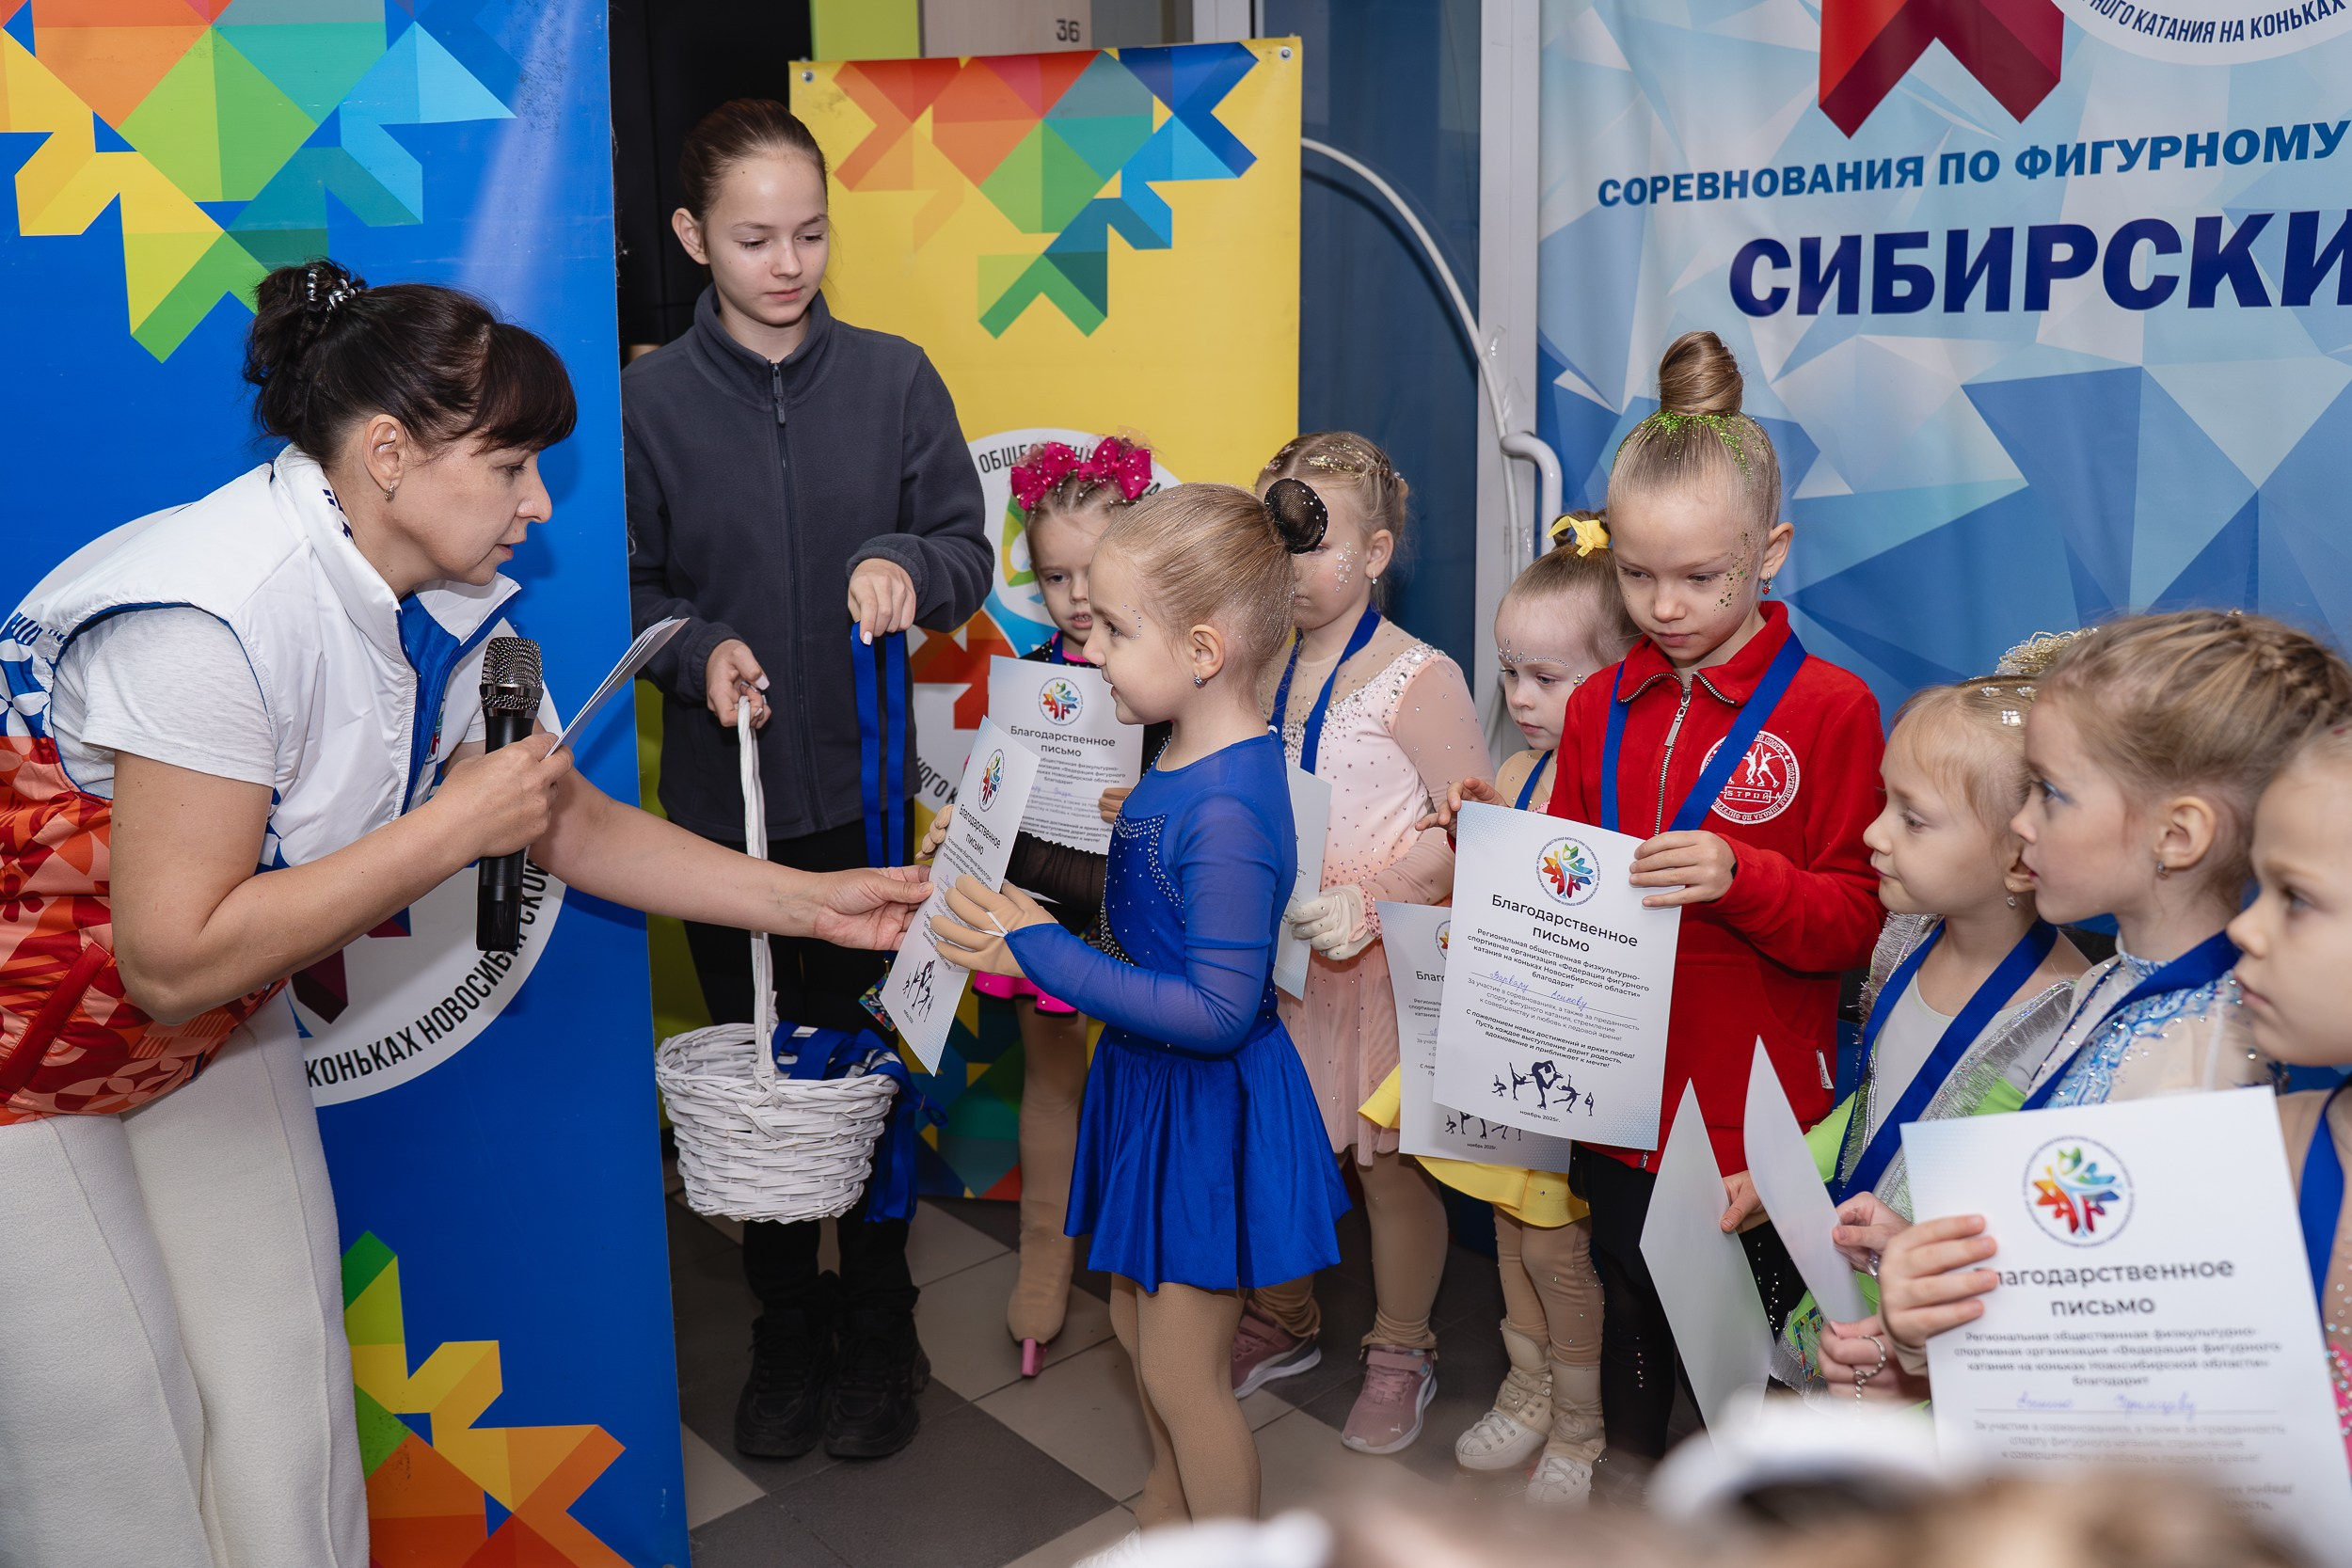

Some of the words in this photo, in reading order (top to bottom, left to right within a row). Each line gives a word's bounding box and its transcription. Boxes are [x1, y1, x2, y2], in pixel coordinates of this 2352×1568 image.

[1057, 19, 1080, 42] 36
[2132, 8, 2215, 43] КАТАНИЯ
[2218, 20, 2245, 43] НА
[2250, 0, 2346, 40] КОНЬКАХ
[1597, 155, 1924, 207] СОРЕВНОВАНИЯ
[1938, 150, 2000, 185] ПО
[2014, 119, 2352, 180] ФИГУРНОМУ
[1729, 209, 2352, 318] СИБИРСКИ
[1010, 725, 1116, 747] Благодарственное
[1041, 744, 1082, 757] письмо
[1492, 894, 1638, 947] Благодарственное
[1533, 927, 1590, 953] письмо
[1468, 935, 1509, 951] спортивная
[1510, 948, 1557, 967] организация
[1559, 963, 1605, 980] «Федерация
[1606, 976, 1649, 991] фигурного
[1473, 945, 1502, 958] катания
[1514, 958, 1542, 971] коньках
[1544, 966, 1603, 989] Новосибирской
[1604, 985, 1641, 998] области»
[1477, 928, 1528, 948] Региональная
[1529, 944, 1581, 965] общественная
[1582, 960, 1640, 981] физкультурно-
[1532, 971, 1574, 989] благодарит
[1476, 980, 1501, 992] участие
[1506, 990, 1558, 1011] соревнованиях,
[1564, 1007, 1583, 1017] также
[1594, 1017, 1640, 1031] преданность
[1485, 999, 1530, 1019] совершенству
[1536, 1015, 1562, 1027] любовь
[1567, 1024, 1597, 1037] ледовой
[1486, 992, 1508, 1005] спорту
[1509, 1000, 1544, 1015] фигурного
[1573, 1019, 1615, 1034] стремление
[1471, 1011, 1513, 1028] пожеланием
[1514, 1024, 1535, 1035] новых
[1536, 1031, 1580, 1047] достижений
[1586, 1045, 1609, 1054] ярких
[1610, 1050, 1635, 1060] побед!
[1475, 1019, 1494, 1030] Пусть
[1495, 1025, 1521, 1037] каждое
[1521, 1034, 1566, 1052] выступление
[1566, 1046, 1589, 1057] дарит
[1590, 1053, 1622, 1064] радость,
[1485, 1030, 1528, 1048] вдохновение
[1535, 1045, 1579, 1061] приближает
[1585, 1058, 1610, 1069] мечте!
[305, 1026, 423, 1088] КОНЬКАХ
[1519, 1110, 1542, 1119] ноябрь
[1974, 1260, 2234, 1289] лагодарственное
[2051, 1296, 2156, 1317] письмо
